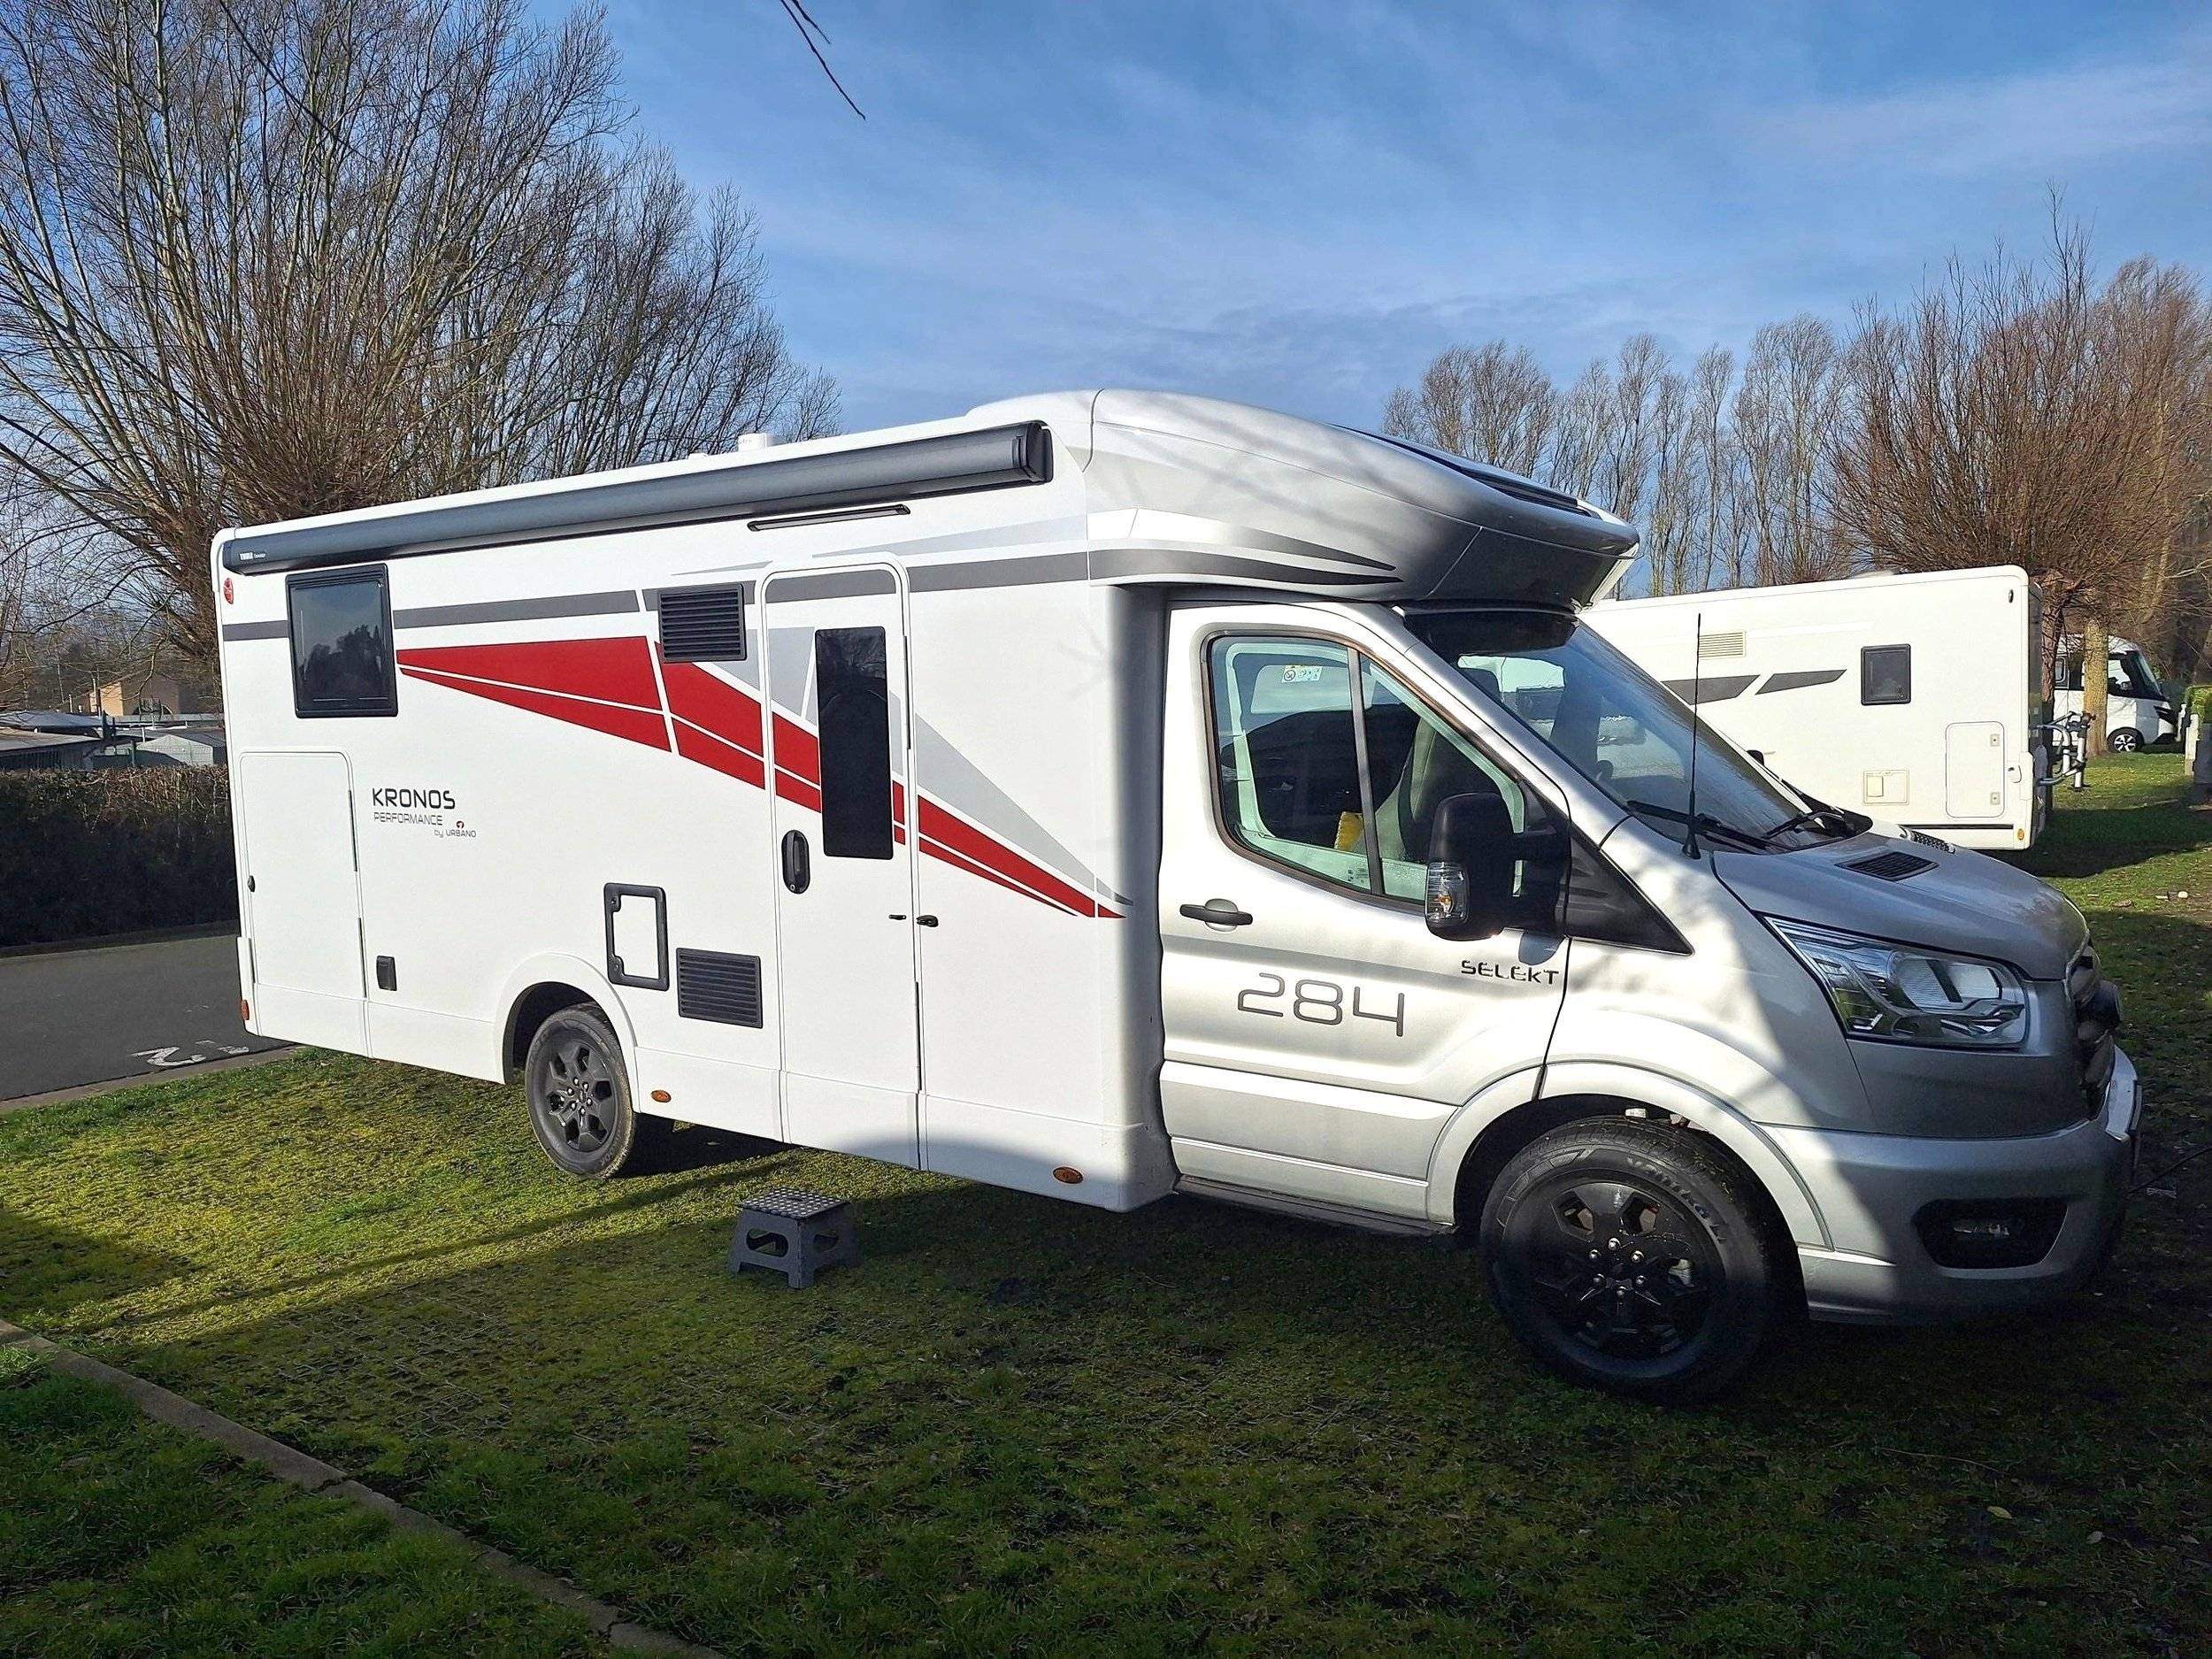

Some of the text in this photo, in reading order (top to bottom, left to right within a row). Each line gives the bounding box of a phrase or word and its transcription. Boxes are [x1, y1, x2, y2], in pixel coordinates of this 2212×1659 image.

[372, 787, 456, 810] KRONOS
[373, 811, 443, 826] PERFORMANCE
[434, 829, 477, 838] by URBANO
[1461, 960, 1559, 985] SELEKT
[1238, 972, 1405, 1037] 284
